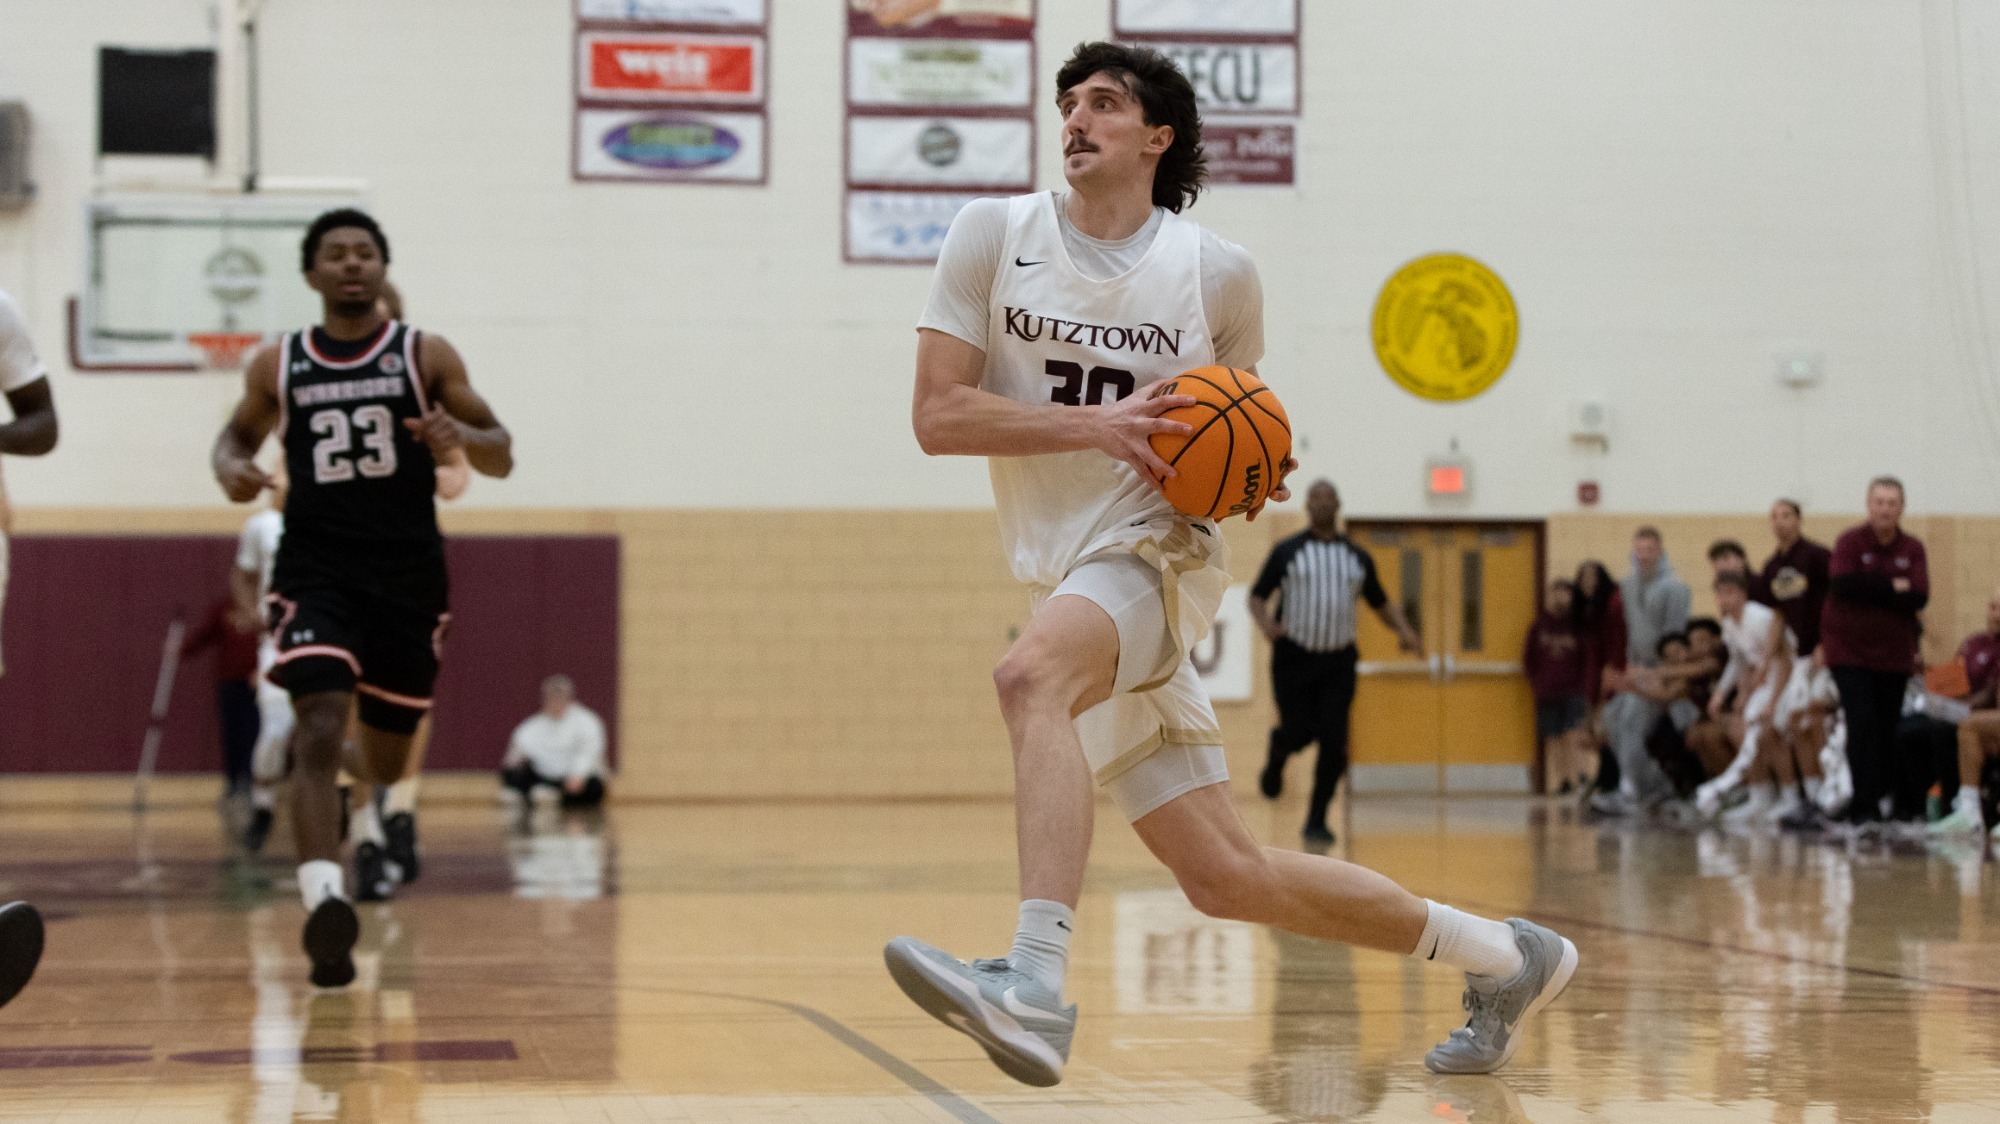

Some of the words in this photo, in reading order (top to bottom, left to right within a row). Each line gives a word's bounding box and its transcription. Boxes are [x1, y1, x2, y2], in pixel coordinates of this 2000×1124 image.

[1169, 48, 1261, 104] ECU
[1004, 306, 1181, 357] KUTZTOWN
[309, 404, 397, 484] 23
